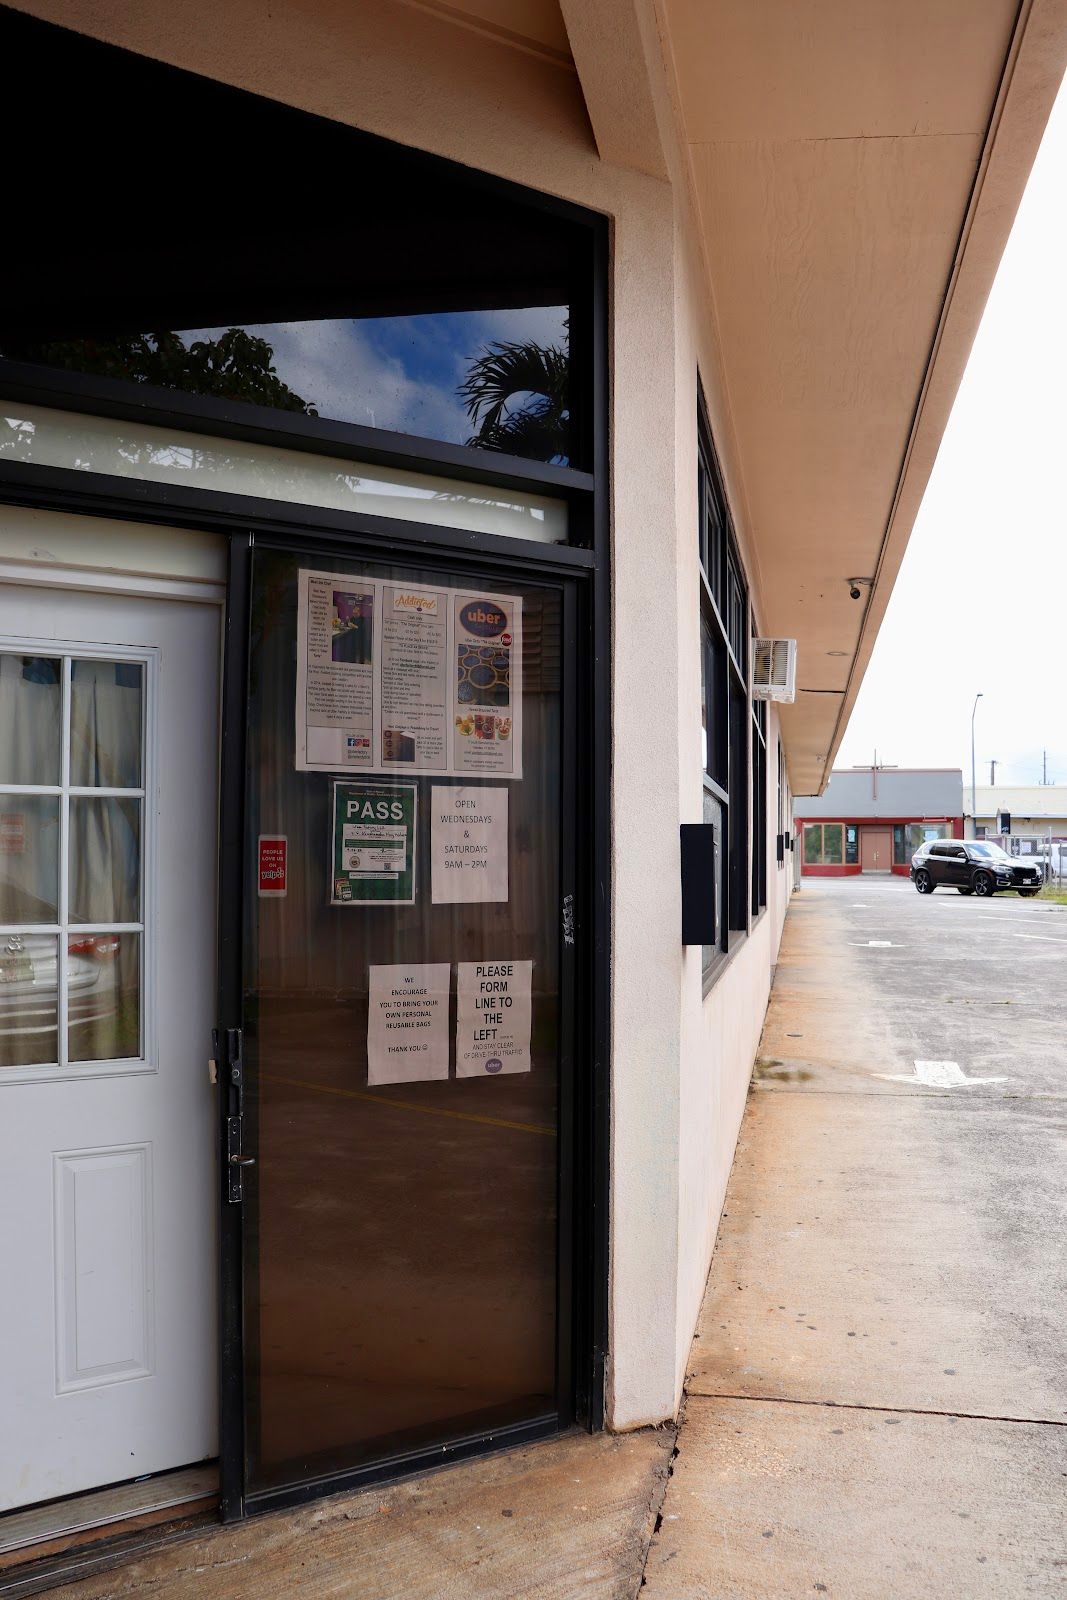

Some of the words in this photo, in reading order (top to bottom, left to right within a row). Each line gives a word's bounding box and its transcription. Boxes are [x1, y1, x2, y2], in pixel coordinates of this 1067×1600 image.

[395, 594, 436, 609] Addicted
[468, 608, 501, 625] uber
[346, 800, 404, 820] PASS
[455, 800, 476, 809] OPEN
[440, 815, 492, 824] WEDNESDAYS
[463, 830, 470, 838] &
[444, 845, 488, 854] SATURDAYS
[444, 860, 463, 869] 9AM
[471, 860, 487, 869] 2PM
[261, 869, 277, 879] yelp
[476, 965, 514, 978] PLEASE
[391, 988, 428, 996] ENCOURAGE
[480, 981, 508, 993] FORM
[475, 997, 496, 1009] LINE
[499, 996, 513, 1008] TO
[483, 1012, 503, 1024] THE
[473, 1028, 498, 1041] LEFT
[472, 1043, 483, 1051] AND
